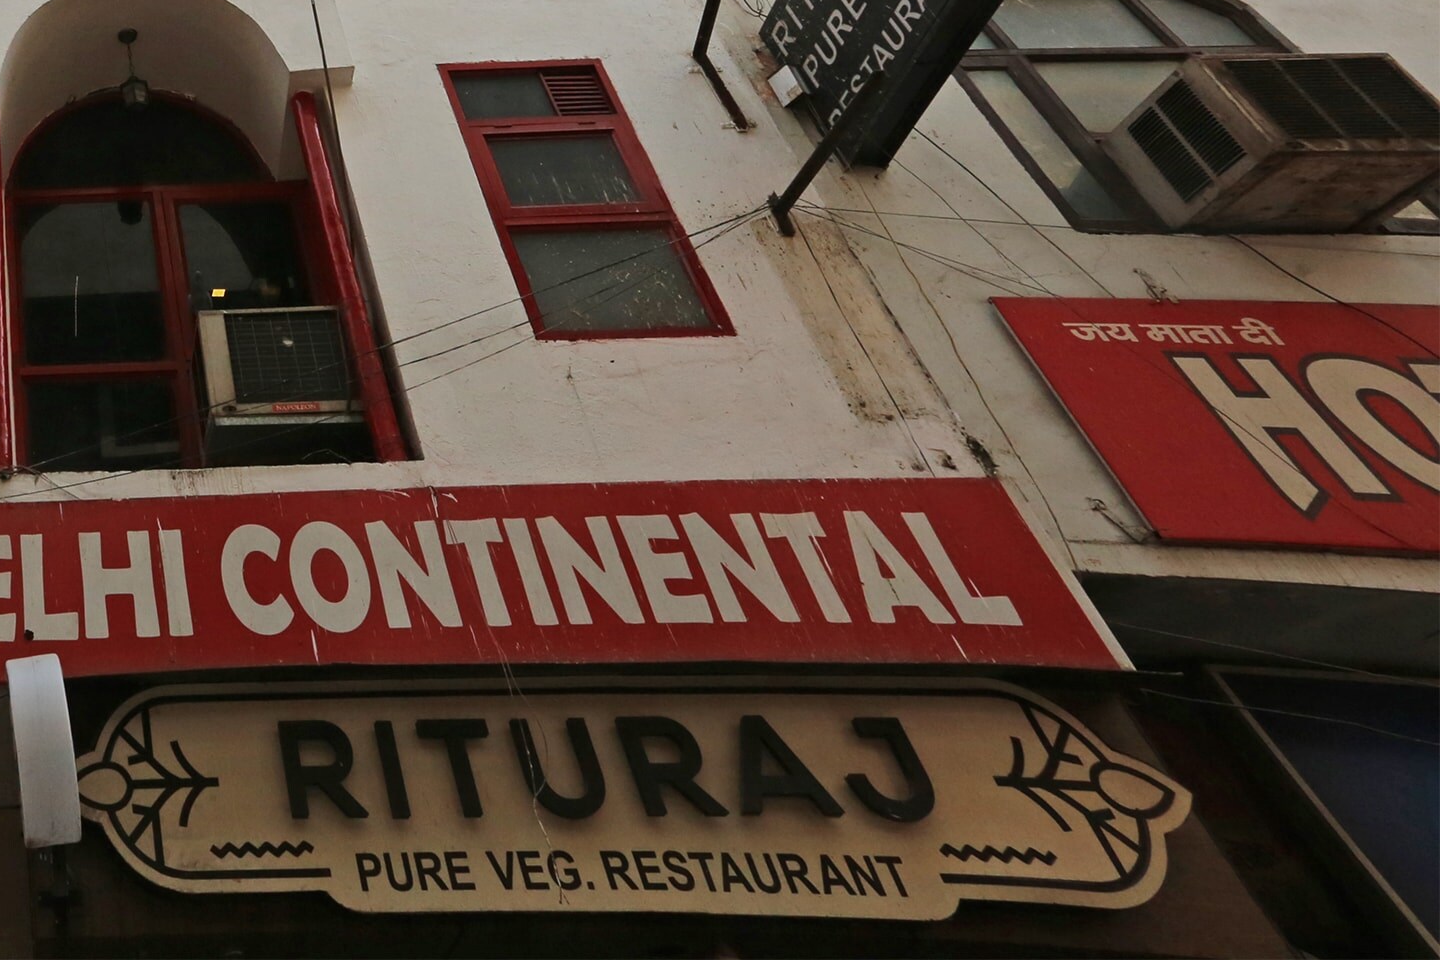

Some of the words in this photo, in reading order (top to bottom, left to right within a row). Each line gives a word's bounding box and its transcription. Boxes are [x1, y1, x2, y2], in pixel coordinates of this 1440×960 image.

[1062, 322, 1139, 342] जय
[1138, 324, 1234, 345] माता
[1232, 317, 1286, 346] दी
[220, 510, 1023, 636] CONTINENTAL
[277, 716, 936, 824] RITURAJ
[355, 851, 476, 892] PURE
[600, 850, 908, 900] RESTAURANT
